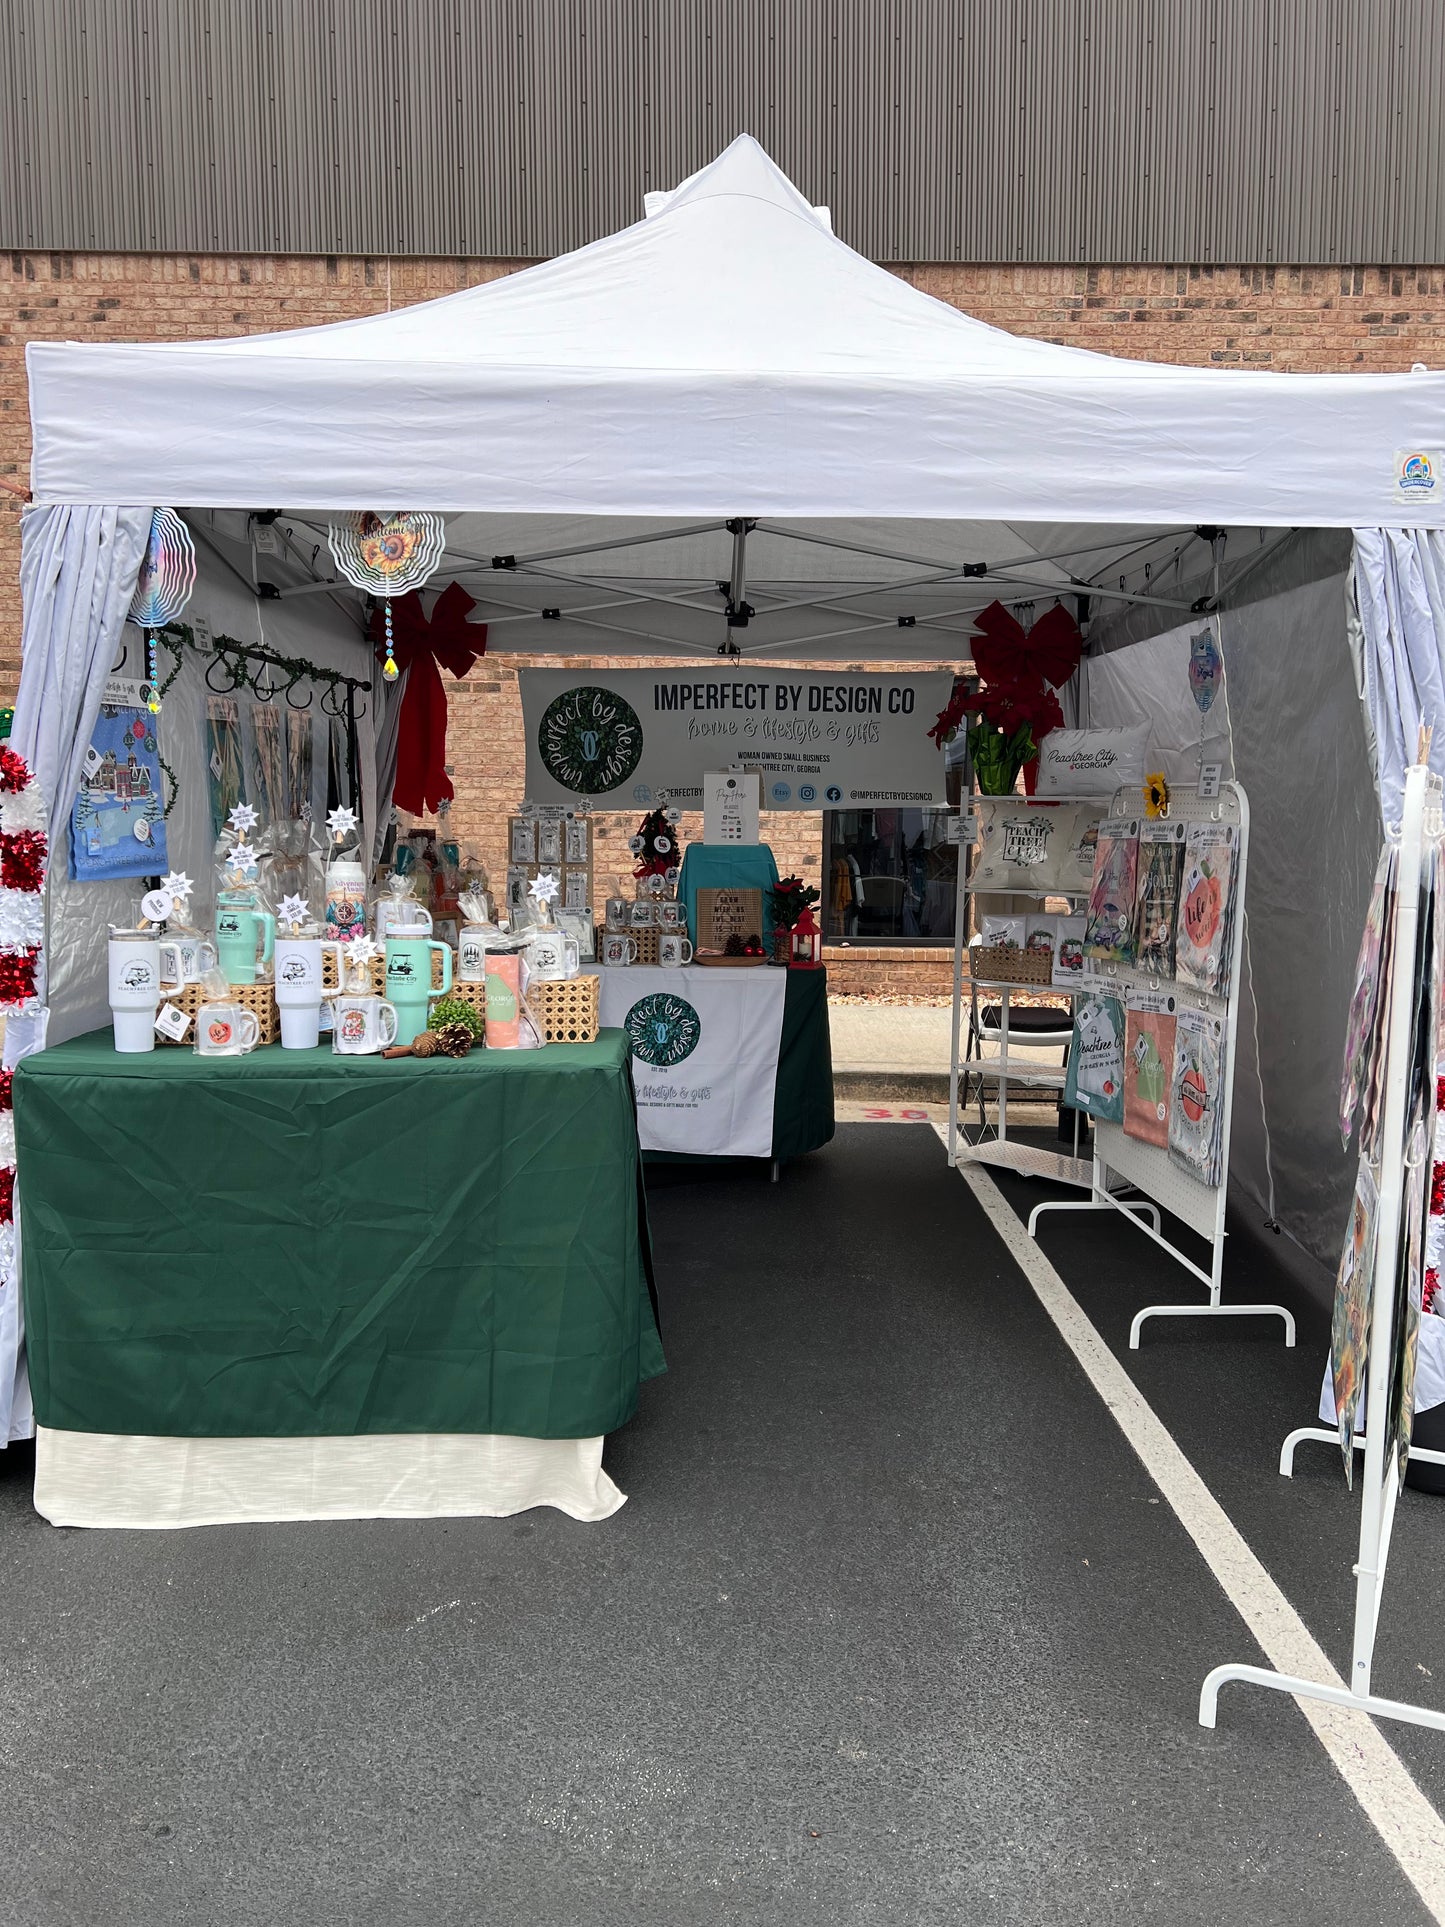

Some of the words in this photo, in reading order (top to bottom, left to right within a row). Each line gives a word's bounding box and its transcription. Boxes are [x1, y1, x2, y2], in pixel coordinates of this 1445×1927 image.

[654, 683, 769, 710] IMPERFECT
[776, 686, 802, 711] BY
[808, 686, 882, 714] DESIGN
[888, 688, 914, 714] CO
[592, 694, 616, 724] by
[548, 694, 587, 787] imperfect
[688, 716, 738, 739] home
[744, 716, 758, 736] &
[762, 716, 821, 744] lifestyle
[826, 720, 841, 740] &
[844, 719, 880, 746] gifts
[600, 723, 635, 786] design
[738, 752, 760, 760] WOMAN
[762, 752, 782, 760] OWNED
[783, 753, 802, 762] SMALL
[803, 754, 830, 763] BUSINESS
[1048, 750, 1094, 763] Peachtree
[782, 764, 796, 773] CITY,
[797, 765, 820, 774] GEORGIA
[774, 789, 788, 797] Etsy
[850, 790, 932, 801] @IMPERFECTBYDESIGNCO
[147, 899, 162, 916] PRODUCT
[156, 899, 164, 908] NEW
[665, 998, 682, 1020] by
[667, 1019, 695, 1061] design
[1075, 1036, 1111, 1056] Peachtree
[643, 1084, 677, 1101] lifestyle
[680, 1086, 689, 1099] &
[691, 1086, 712, 1102] gifts
